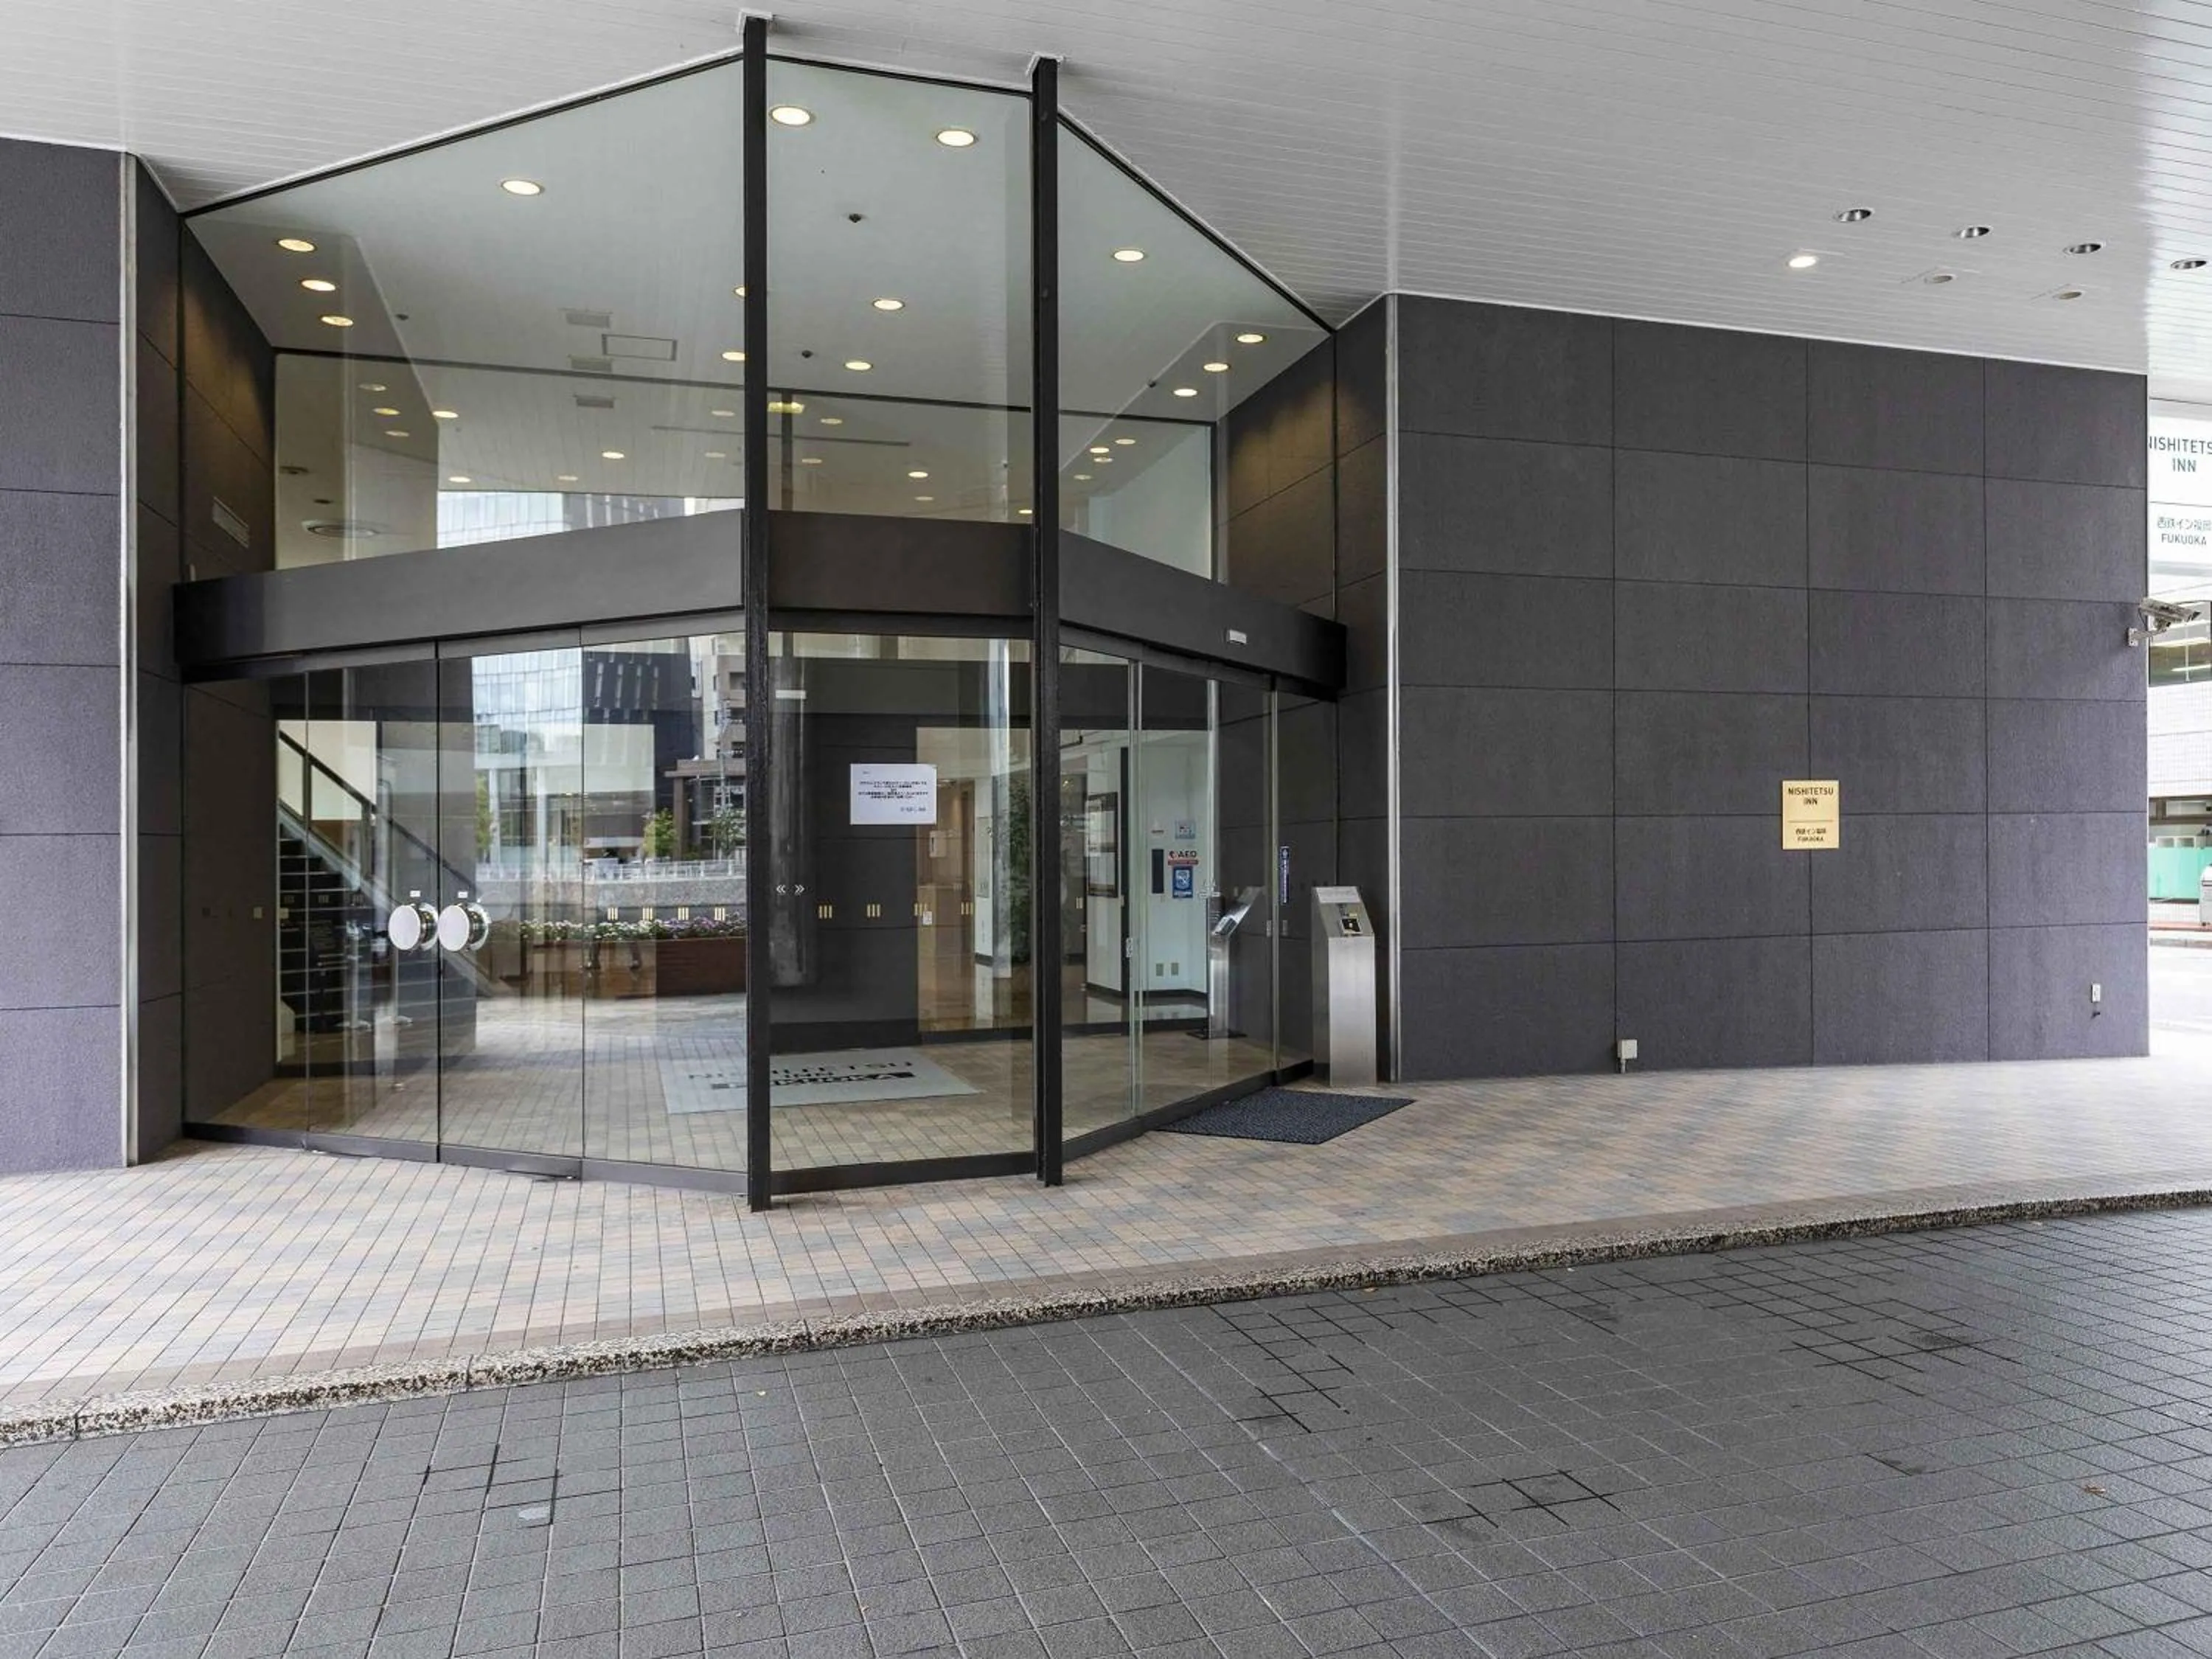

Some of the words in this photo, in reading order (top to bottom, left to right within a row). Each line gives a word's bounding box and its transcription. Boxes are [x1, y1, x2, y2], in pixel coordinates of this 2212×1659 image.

[2171, 457, 2197, 473] INN
[2161, 533, 2207, 546] FUKUOKA
[1788, 787, 1834, 795] NISHITETSU
